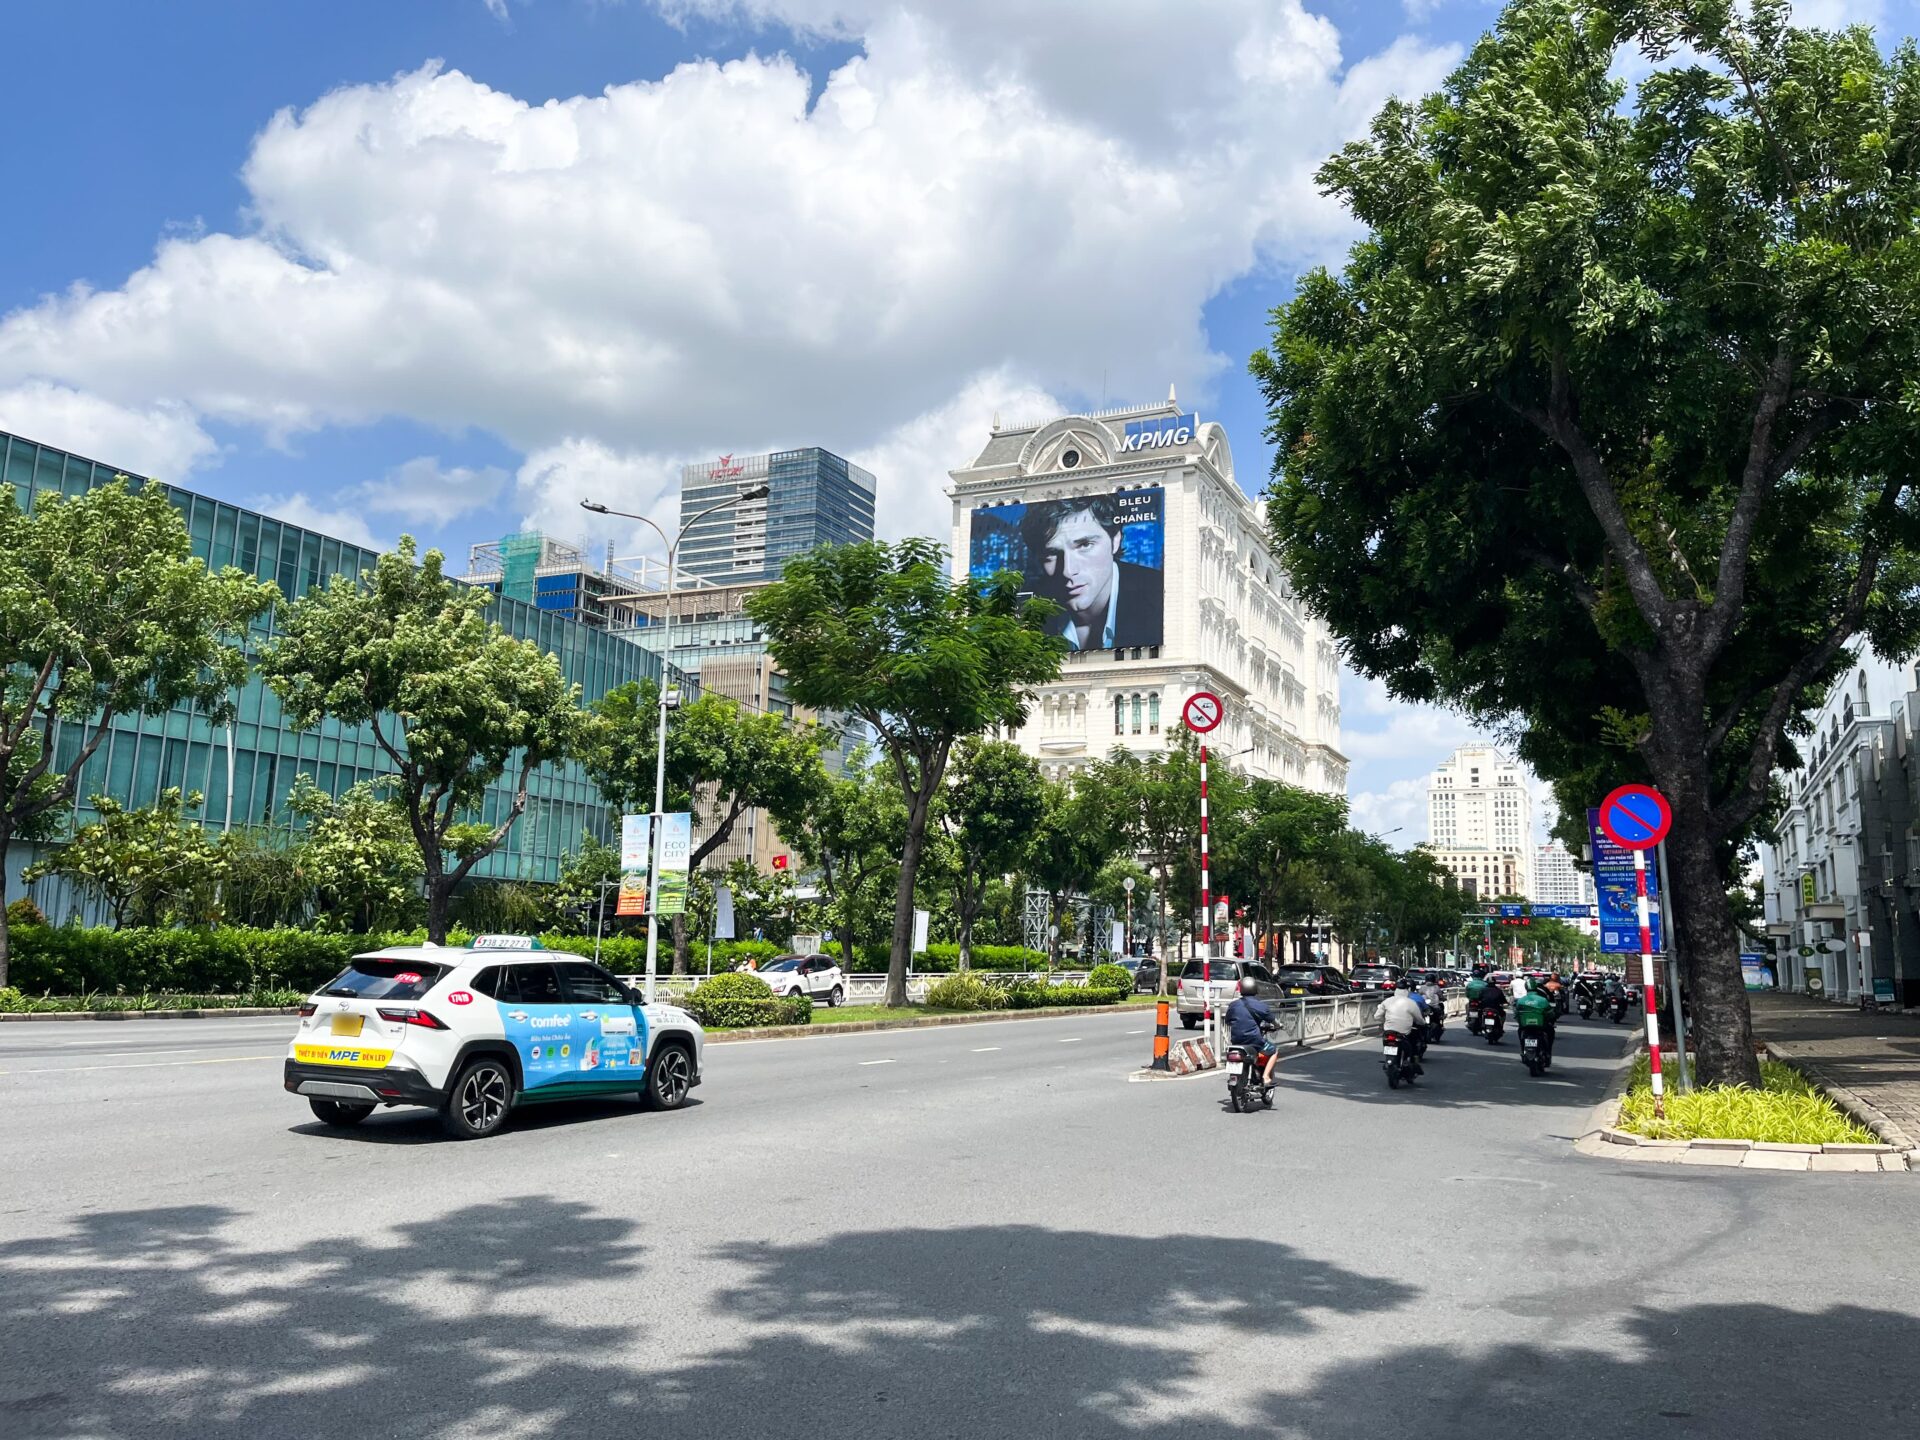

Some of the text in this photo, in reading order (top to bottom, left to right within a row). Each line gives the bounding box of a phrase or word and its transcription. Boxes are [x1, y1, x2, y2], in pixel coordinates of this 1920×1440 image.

[1121, 427, 1189, 453] KPMG
[1119, 496, 1151, 507] BLEU
[1113, 512, 1157, 524] CHANEL
[665, 841, 686, 849] ECO
[329, 1050, 360, 1061] MPE
